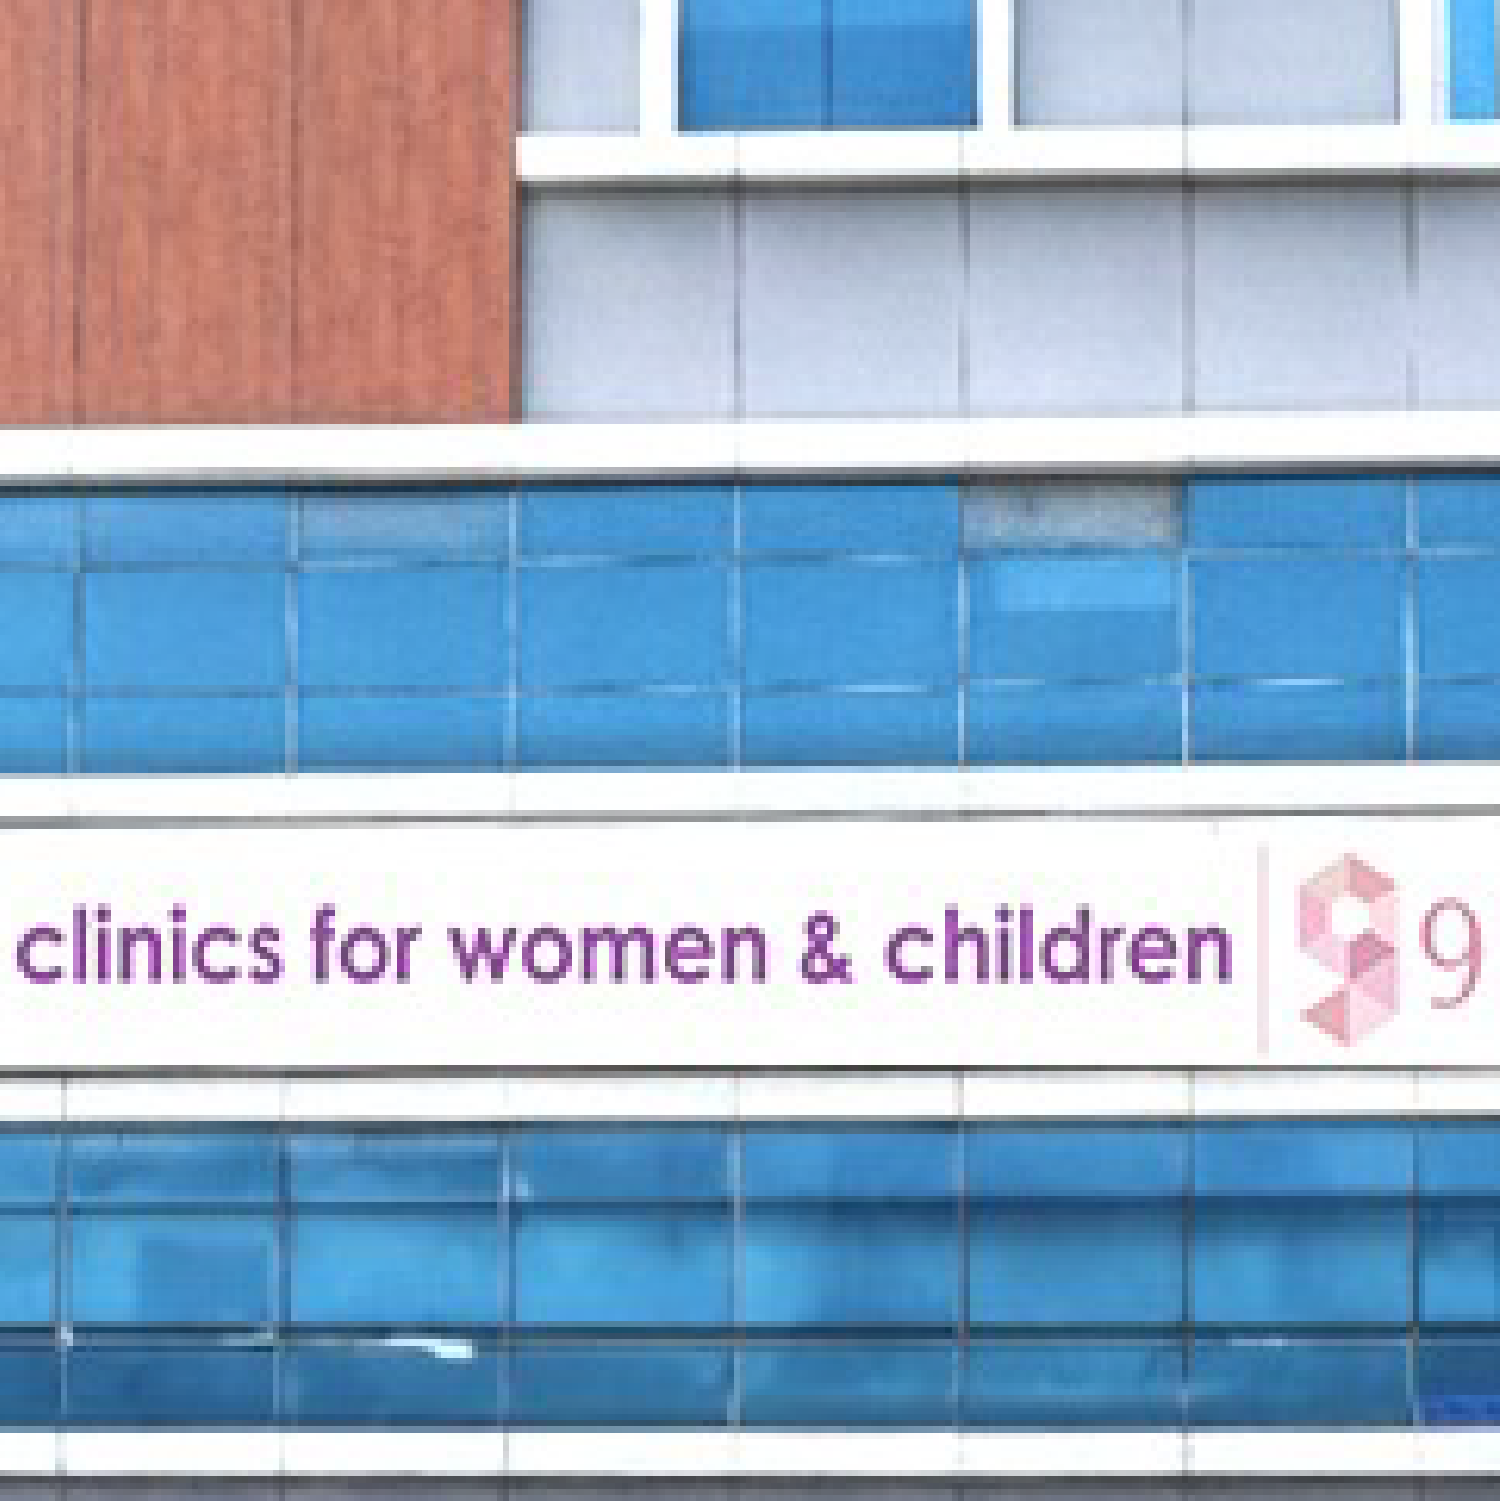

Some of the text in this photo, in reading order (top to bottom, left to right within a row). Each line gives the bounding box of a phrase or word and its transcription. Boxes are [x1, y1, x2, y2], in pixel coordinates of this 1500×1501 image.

[16, 903, 285, 985] clinics
[307, 903, 422, 985] for
[447, 924, 769, 985] women
[801, 910, 857, 985] &
[883, 903, 1233, 985] children
